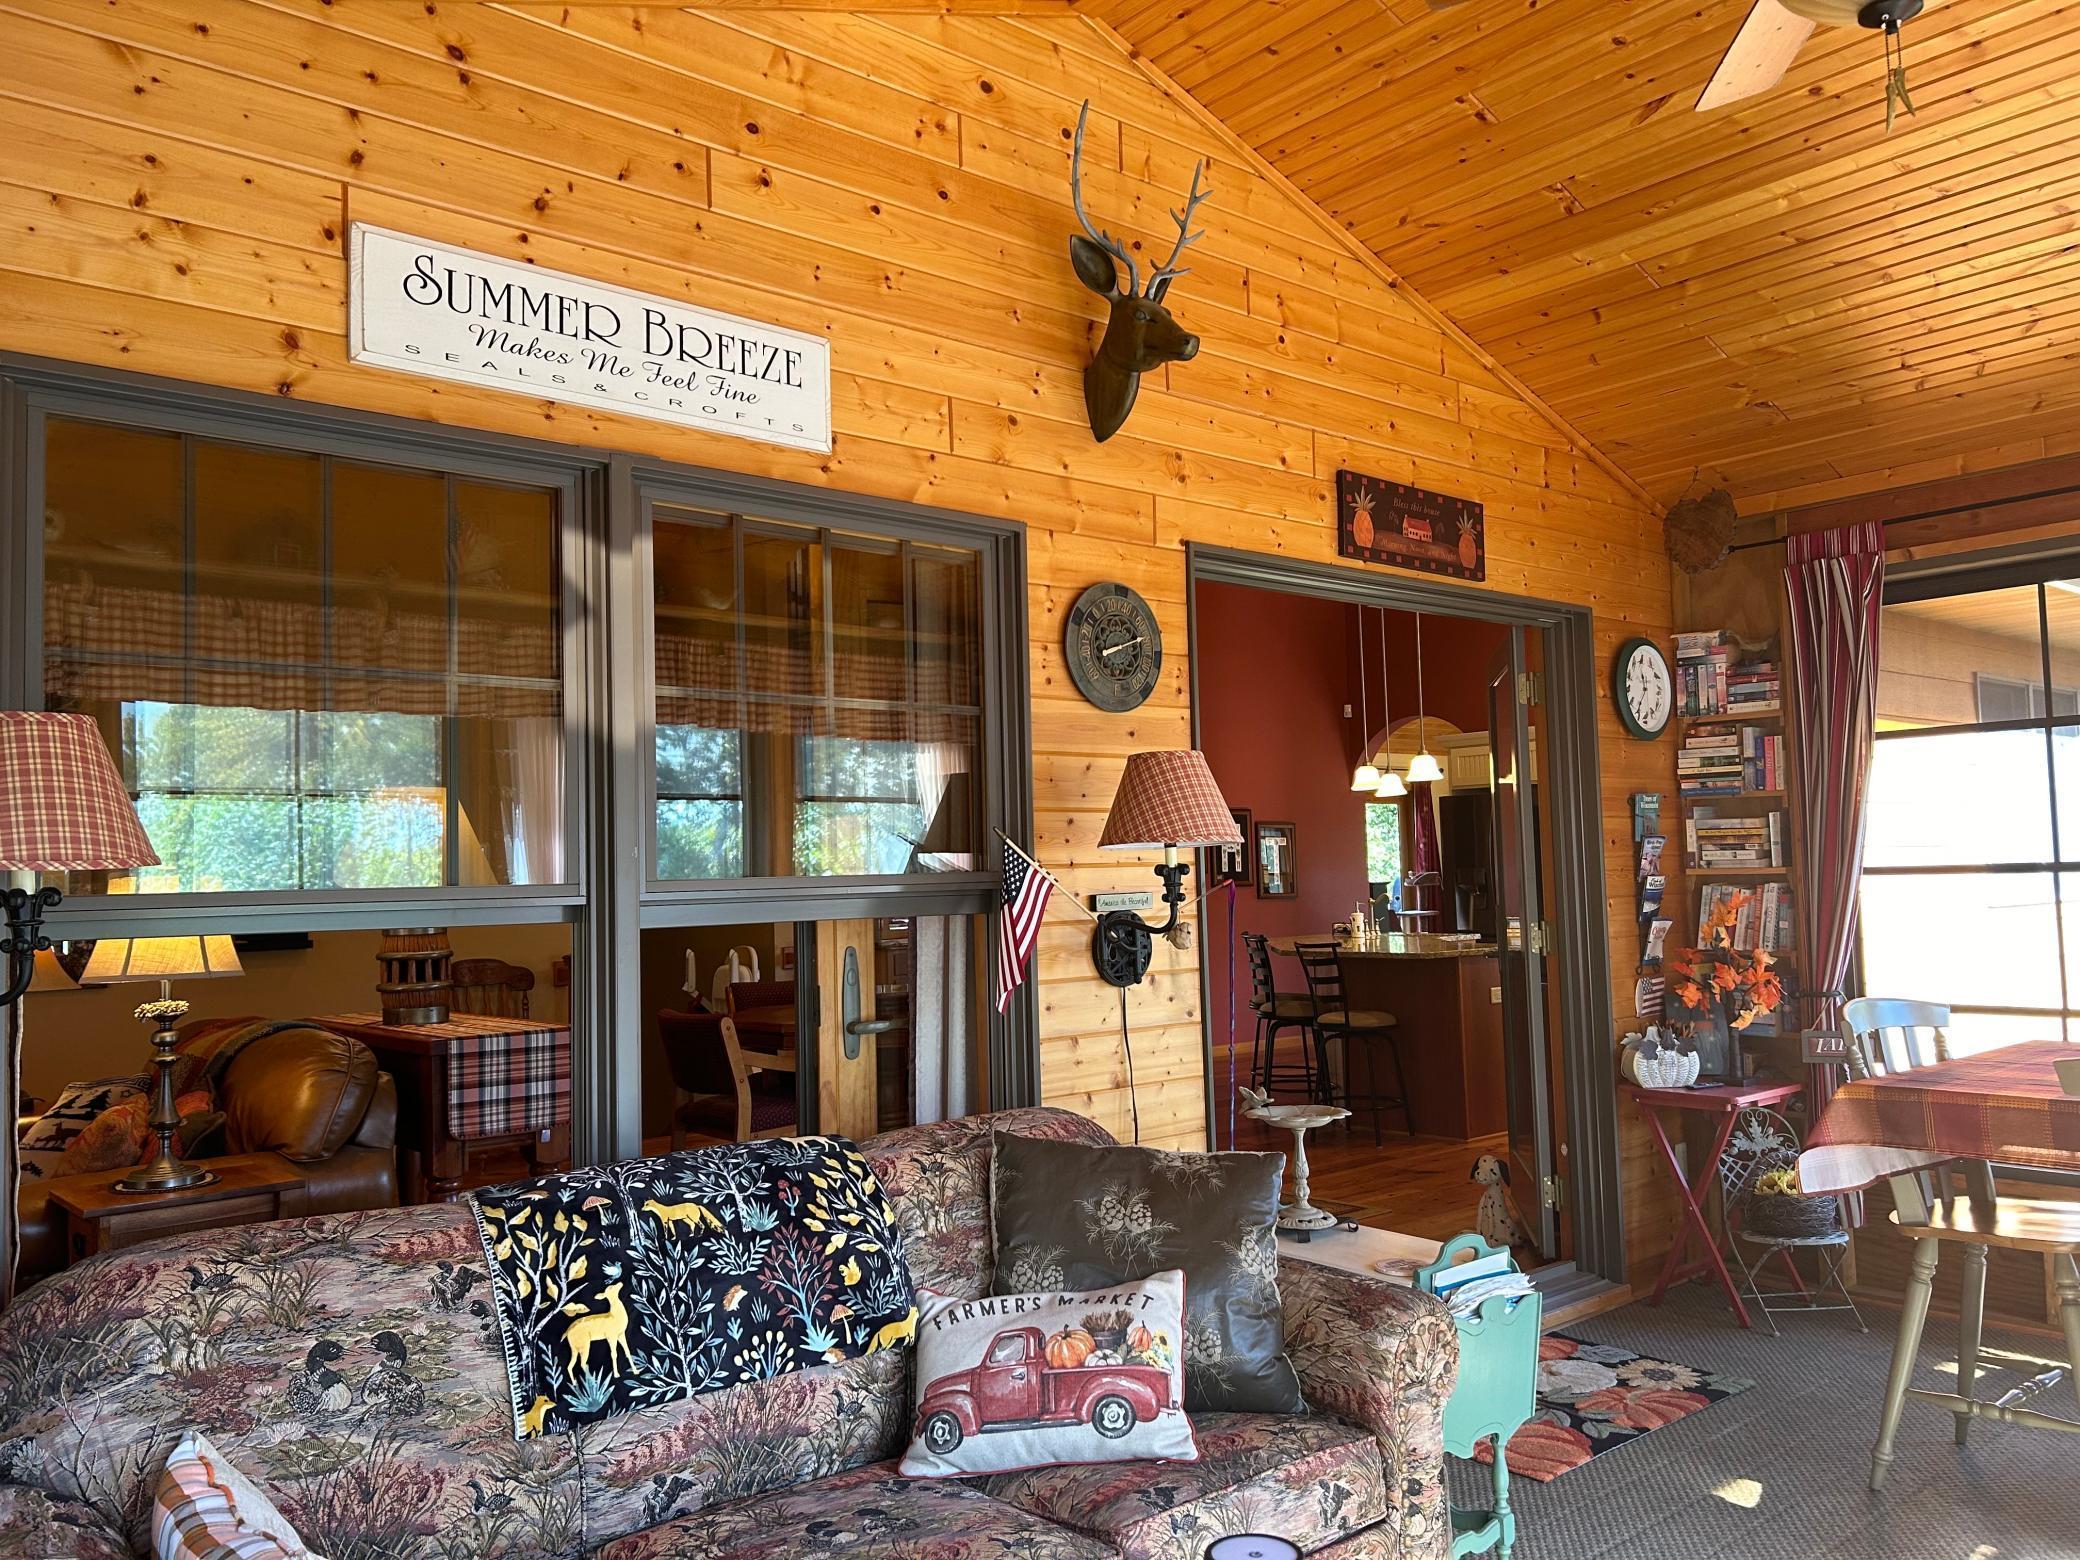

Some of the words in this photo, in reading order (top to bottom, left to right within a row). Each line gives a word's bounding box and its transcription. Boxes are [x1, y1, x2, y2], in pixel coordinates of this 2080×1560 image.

[403, 254, 622, 349] SUMMER
[642, 307, 804, 390] BREEZE
[468, 323, 574, 366] Makes
[580, 346, 635, 379] Me
[642, 360, 700, 392] Feel
[705, 373, 761, 405] Fine
[933, 1296, 1042, 1331] FARMER'S
[1058, 1291, 1155, 1312] MARKET
